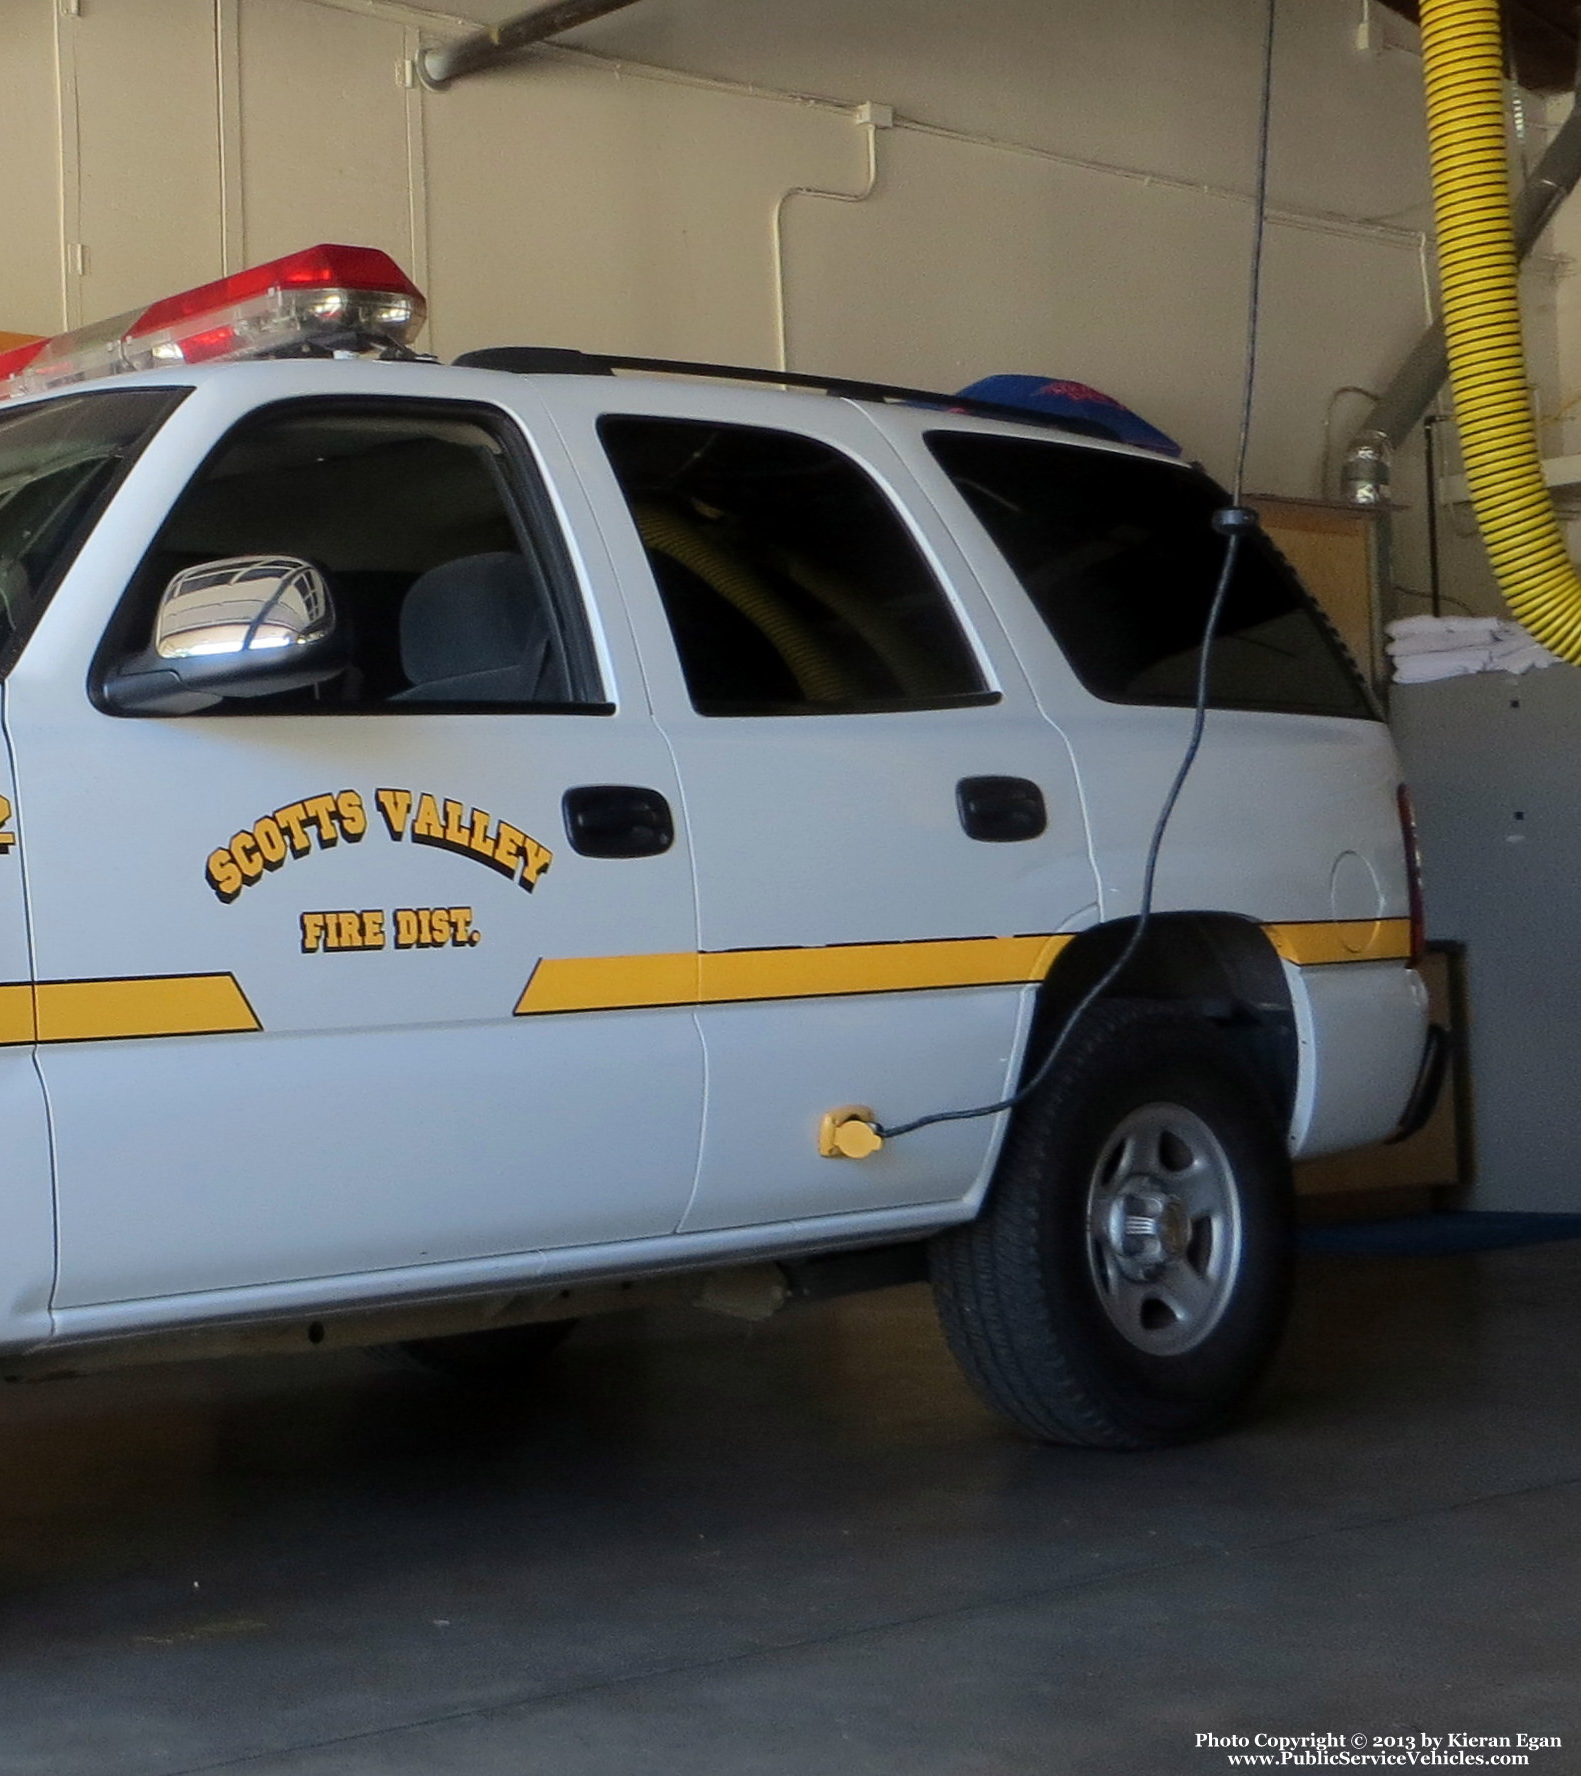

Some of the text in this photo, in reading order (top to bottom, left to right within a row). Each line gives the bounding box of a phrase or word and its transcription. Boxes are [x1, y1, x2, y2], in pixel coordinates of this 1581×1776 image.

[205, 788, 553, 904] SCOTTS VALLEY
[301, 907, 481, 953] FIRE DIST.
